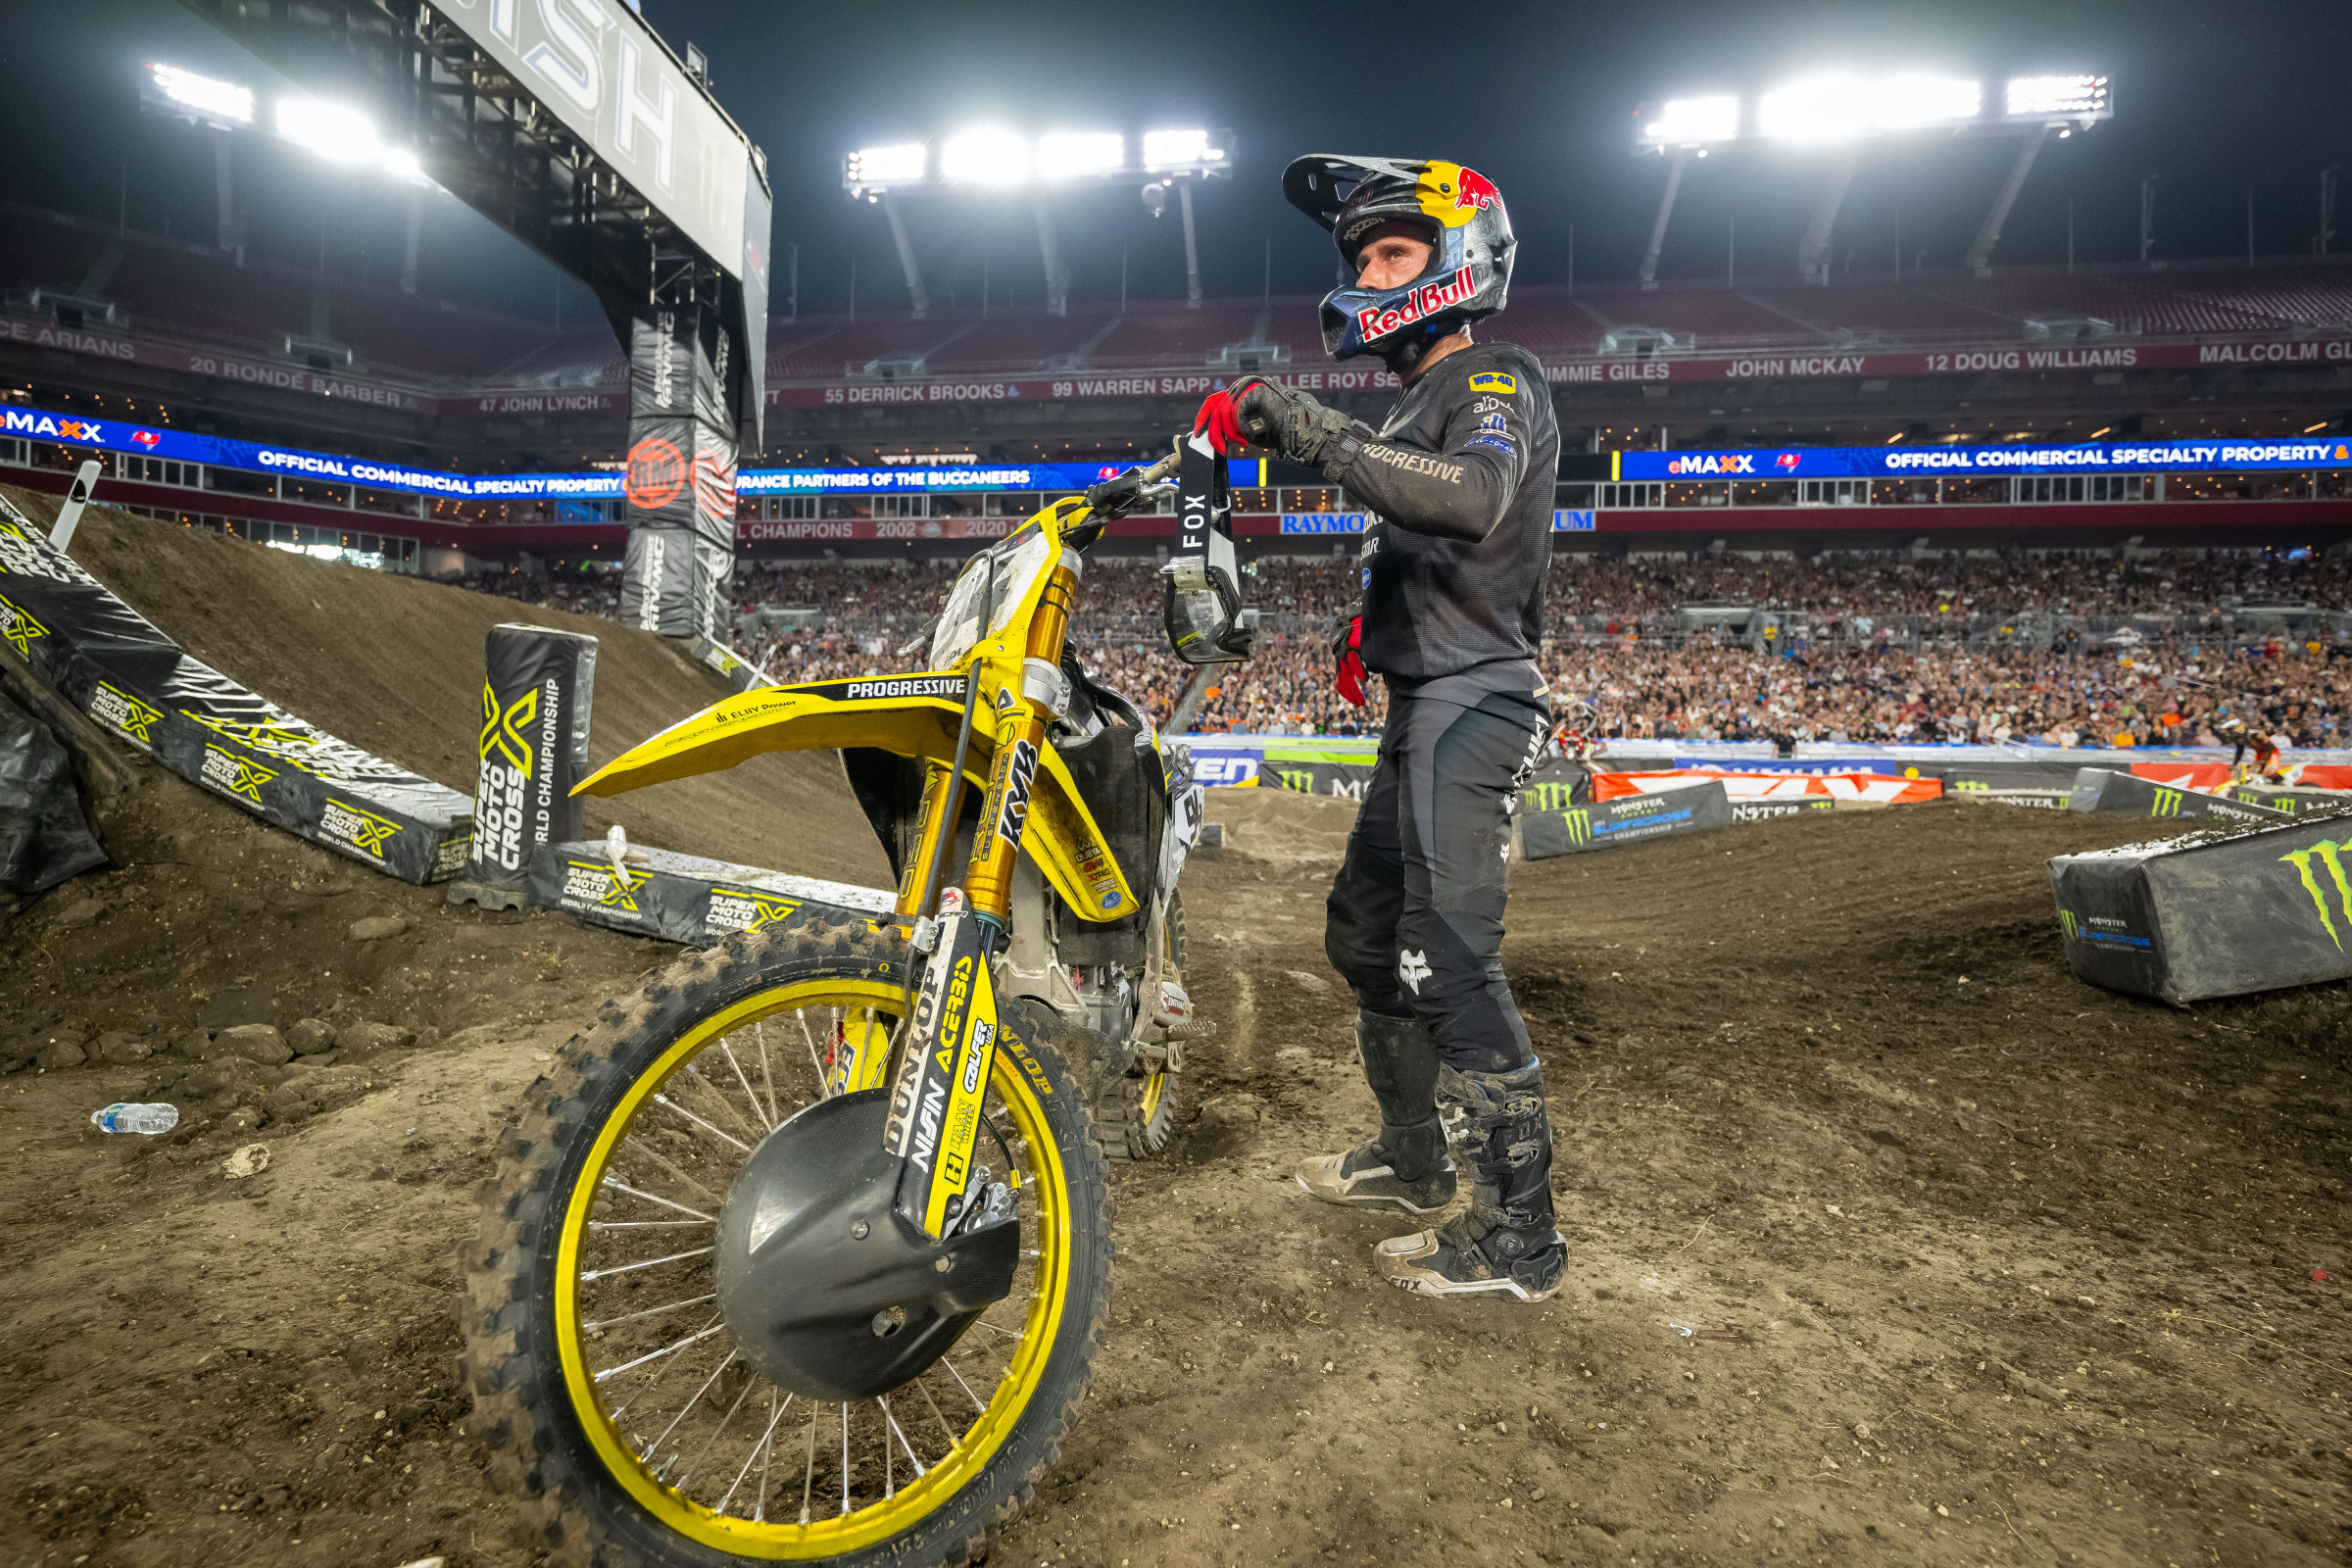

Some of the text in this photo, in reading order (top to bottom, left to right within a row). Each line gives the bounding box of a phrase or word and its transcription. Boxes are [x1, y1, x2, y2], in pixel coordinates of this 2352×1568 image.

[1359, 265, 1477, 343] Red Bull
[36, 327, 135, 361] ARIANS
[2199, 342, 2319, 364] MALCOLM
[1727, 357, 1865, 378] JOHN MCKAY
[1926, 349, 2137, 370] 12 DOUG WILLIAMS
[190, 357, 402, 408] 20 RONDE BARBER
[1291, 373, 1323, 390] LEE
[1328, 372, 1367, 389] ROY
[1473, 374, 1513, 388] WD-40
[1609, 364, 1670, 381] GILES
[825, 383, 1004, 404] 55 DERRICK BROOKS
[1053, 377, 1210, 398] 99 WARREN SAPP
[479, 395, 599, 412] 47 JOHN LYNCH
[1668, 454, 1754, 474] eMAXX
[1886, 444, 2349, 468] OFFICIAL COMMERCIAL SPECIALTY PROPERTY &
[258, 451, 619, 494] OFFICIAL COMMERCIAL SPECIALTY PROPERTY
[735, 469, 1030, 489] URANCE PARTNERS OF THE BUCCANEERS
[751, 522, 854, 539] CHAMPIONS
[877, 521, 916, 538] 2002
[966, 519, 1006, 536] 2020
[1183, 494, 1205, 548] FOX
[1283, 514, 1364, 533] RAYMO
[95, 685, 131, 710] SUPER
[848, 678, 965, 699] PROGRESSIVE
[91, 702, 126, 725] CROSS
[94, 696, 127, 718] MOTO
[761, 701, 797, 710] Power
[89, 712, 154, 752] WORLD CHAMPIONSHIP
[205, 749, 241, 772] SUPER
[206, 758, 237, 778] MOTO
[536, 678, 560, 846] CHAMPIONSHIP RLD
[201, 764, 235, 787] CROSS
[200, 775, 266, 811] WORLD CHAMPIONSHIP
[998, 739, 1038, 852] KYB
[324, 804, 365, 827] SUPER
[472, 758, 492, 864] SUPER
[485, 764, 506, 862] MOTO
[981, 751, 1009, 861] SUSPENSION
[1610, 798, 1665, 814] MONSTER
[323, 812, 360, 833] MOTO
[500, 765, 524, 871] CROSS
[320, 819, 360, 841] CROSS
[1614, 824, 1673, 840] CHAMPIONSHIP
[318, 832, 386, 866] WORLD CHAMPIONSHIP
[567, 867, 611, 884] SUPER
[568, 877, 607, 893] MOTO
[1087, 868, 1110, 882] XTRIG
[563, 885, 606, 901] CROSS
[710, 896, 757, 912] SUPER
[561, 898, 642, 921] WORLD CHAMPIONSHIP
[710, 906, 752, 920] MOTO
[705, 927, 727, 937] WORL
[706, 913, 753, 930] CROSS
[2088, 916, 2128, 928] MONSTER
[985, 1024, 995, 1047] USA
[885, 965, 941, 1153] DUNLOP
[962, 1017, 990, 1094] GALFER
[1000, 1024, 1054, 1095] NLOP
[912, 1077, 948, 1173] NISSIN
[949, 1098, 968, 1151] HAAN
[961, 1102, 976, 1145] WHEELS
[1389, 1277, 1421, 1291] FOX
